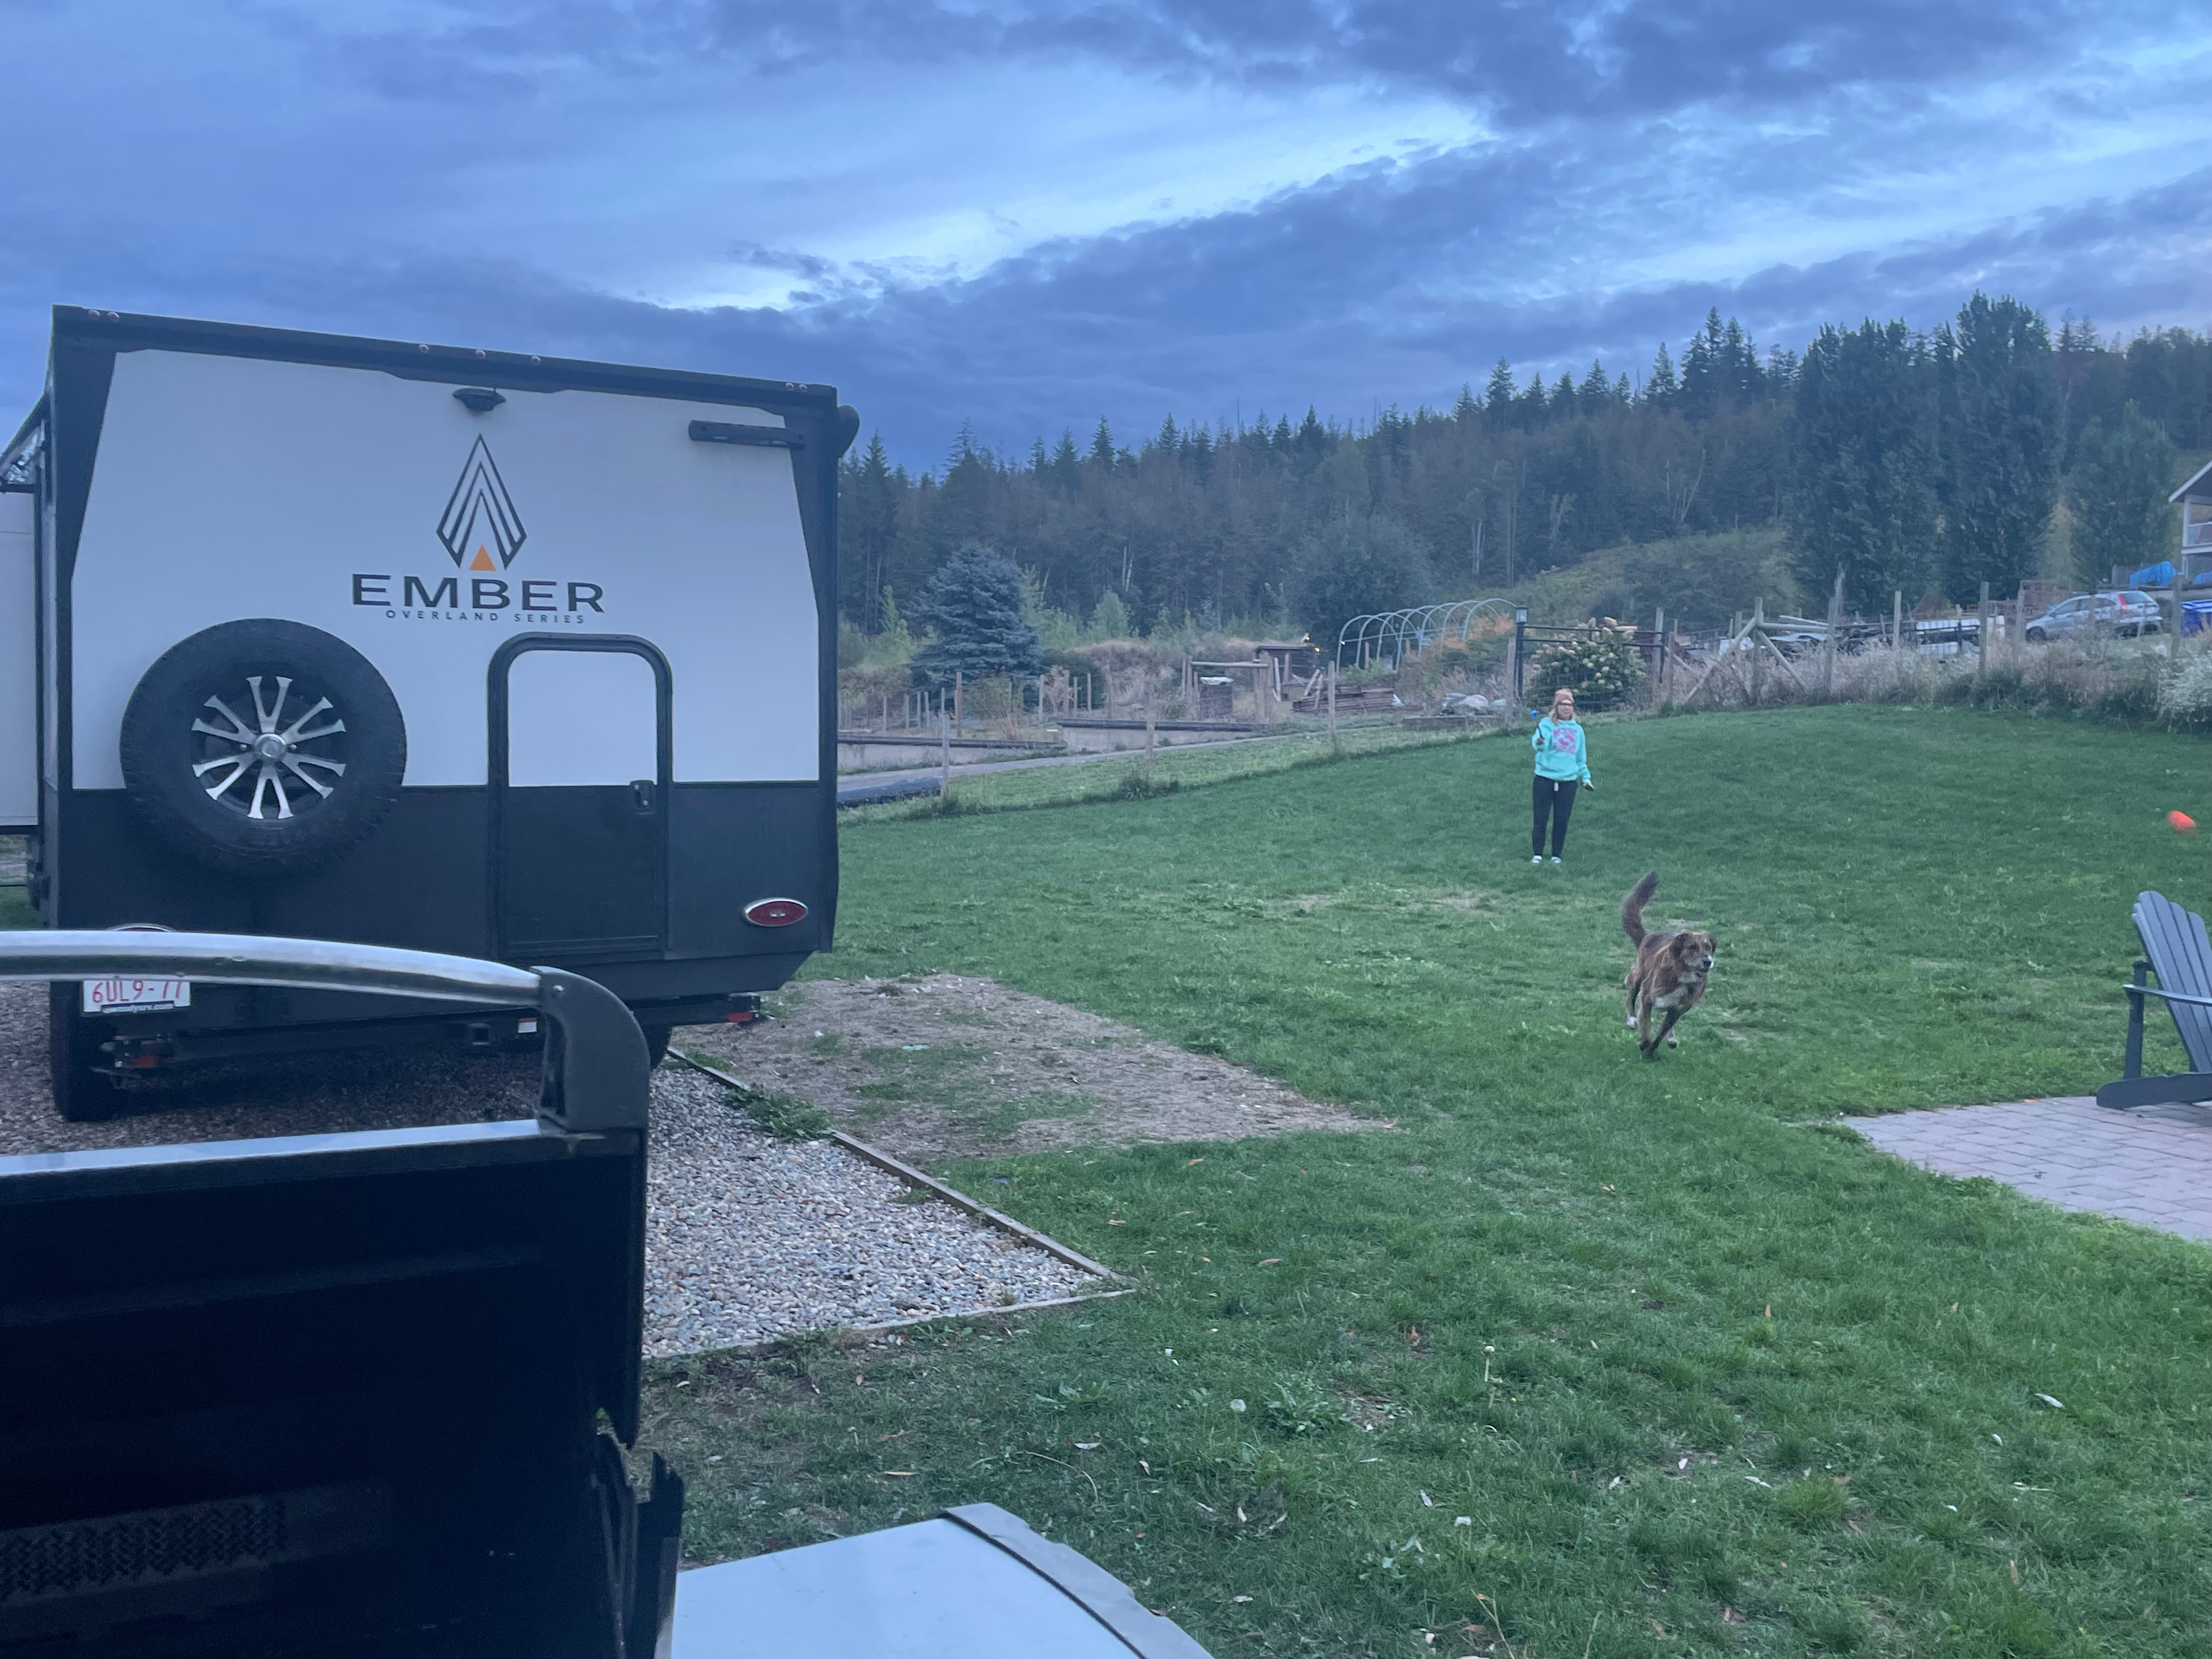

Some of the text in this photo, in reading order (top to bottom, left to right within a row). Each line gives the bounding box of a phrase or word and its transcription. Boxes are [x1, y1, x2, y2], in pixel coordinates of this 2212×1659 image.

[352, 573, 605, 613] EMBER
[385, 609, 584, 624] OVERLAND SERIES
